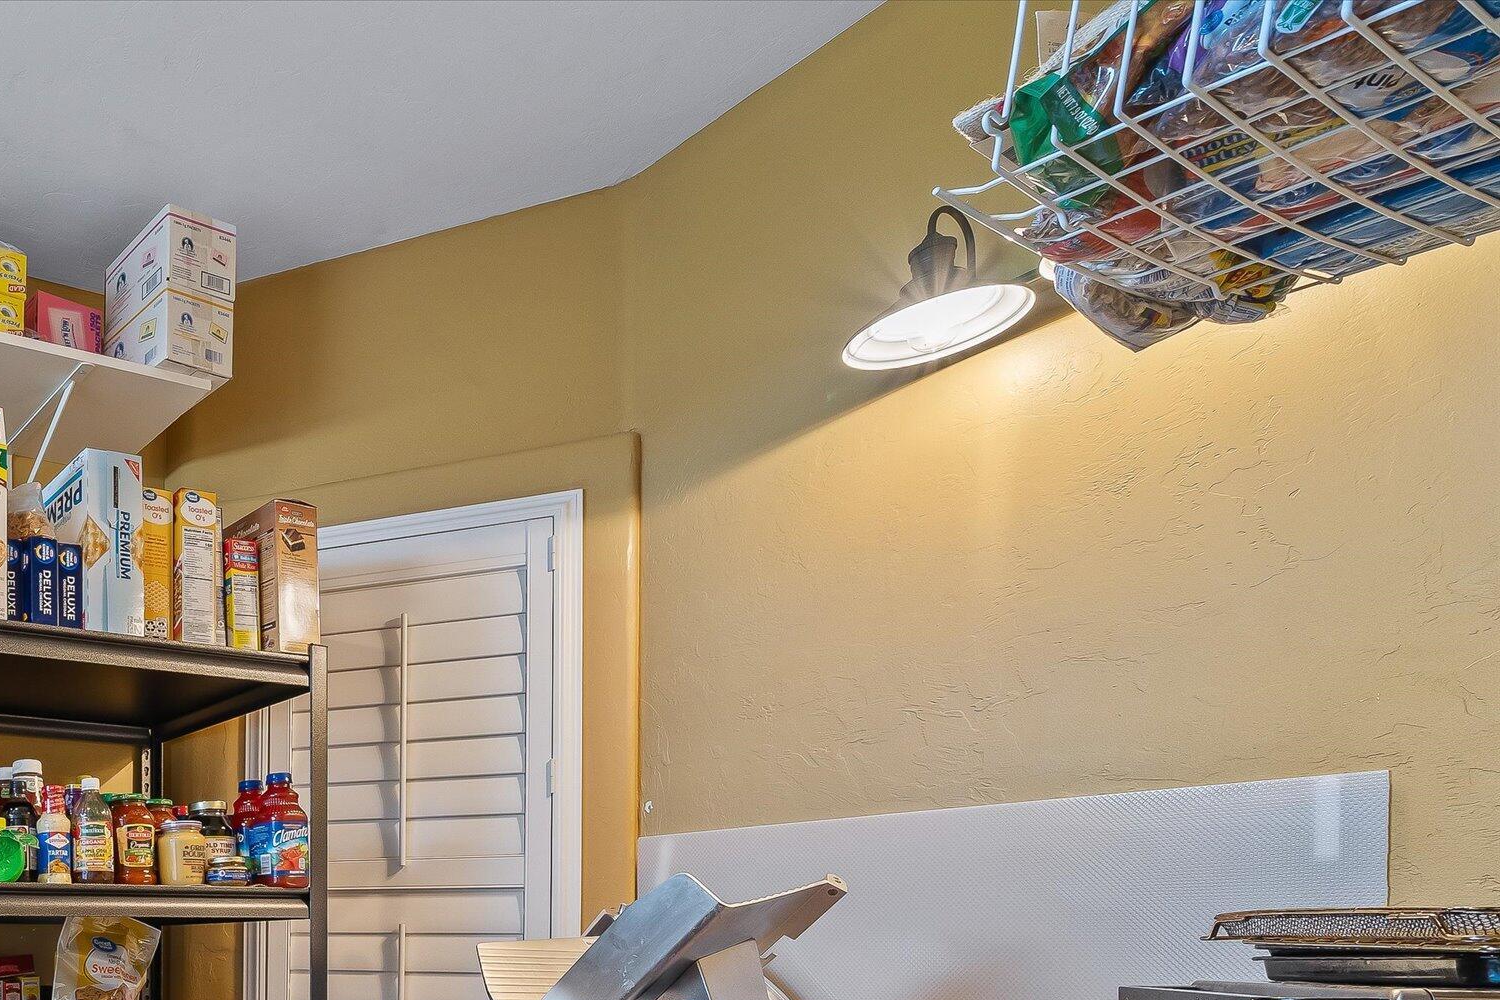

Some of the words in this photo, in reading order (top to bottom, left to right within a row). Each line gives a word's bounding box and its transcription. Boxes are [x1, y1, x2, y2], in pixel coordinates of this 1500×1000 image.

[144, 503, 169, 514] Toasted
[188, 505, 213, 516] Toasted
[120, 511, 131, 580] PREMIUM
[7, 571, 16, 617] DELUXE
[43, 570, 52, 616] DELUXE
[67, 576, 76, 622] DELUXE
